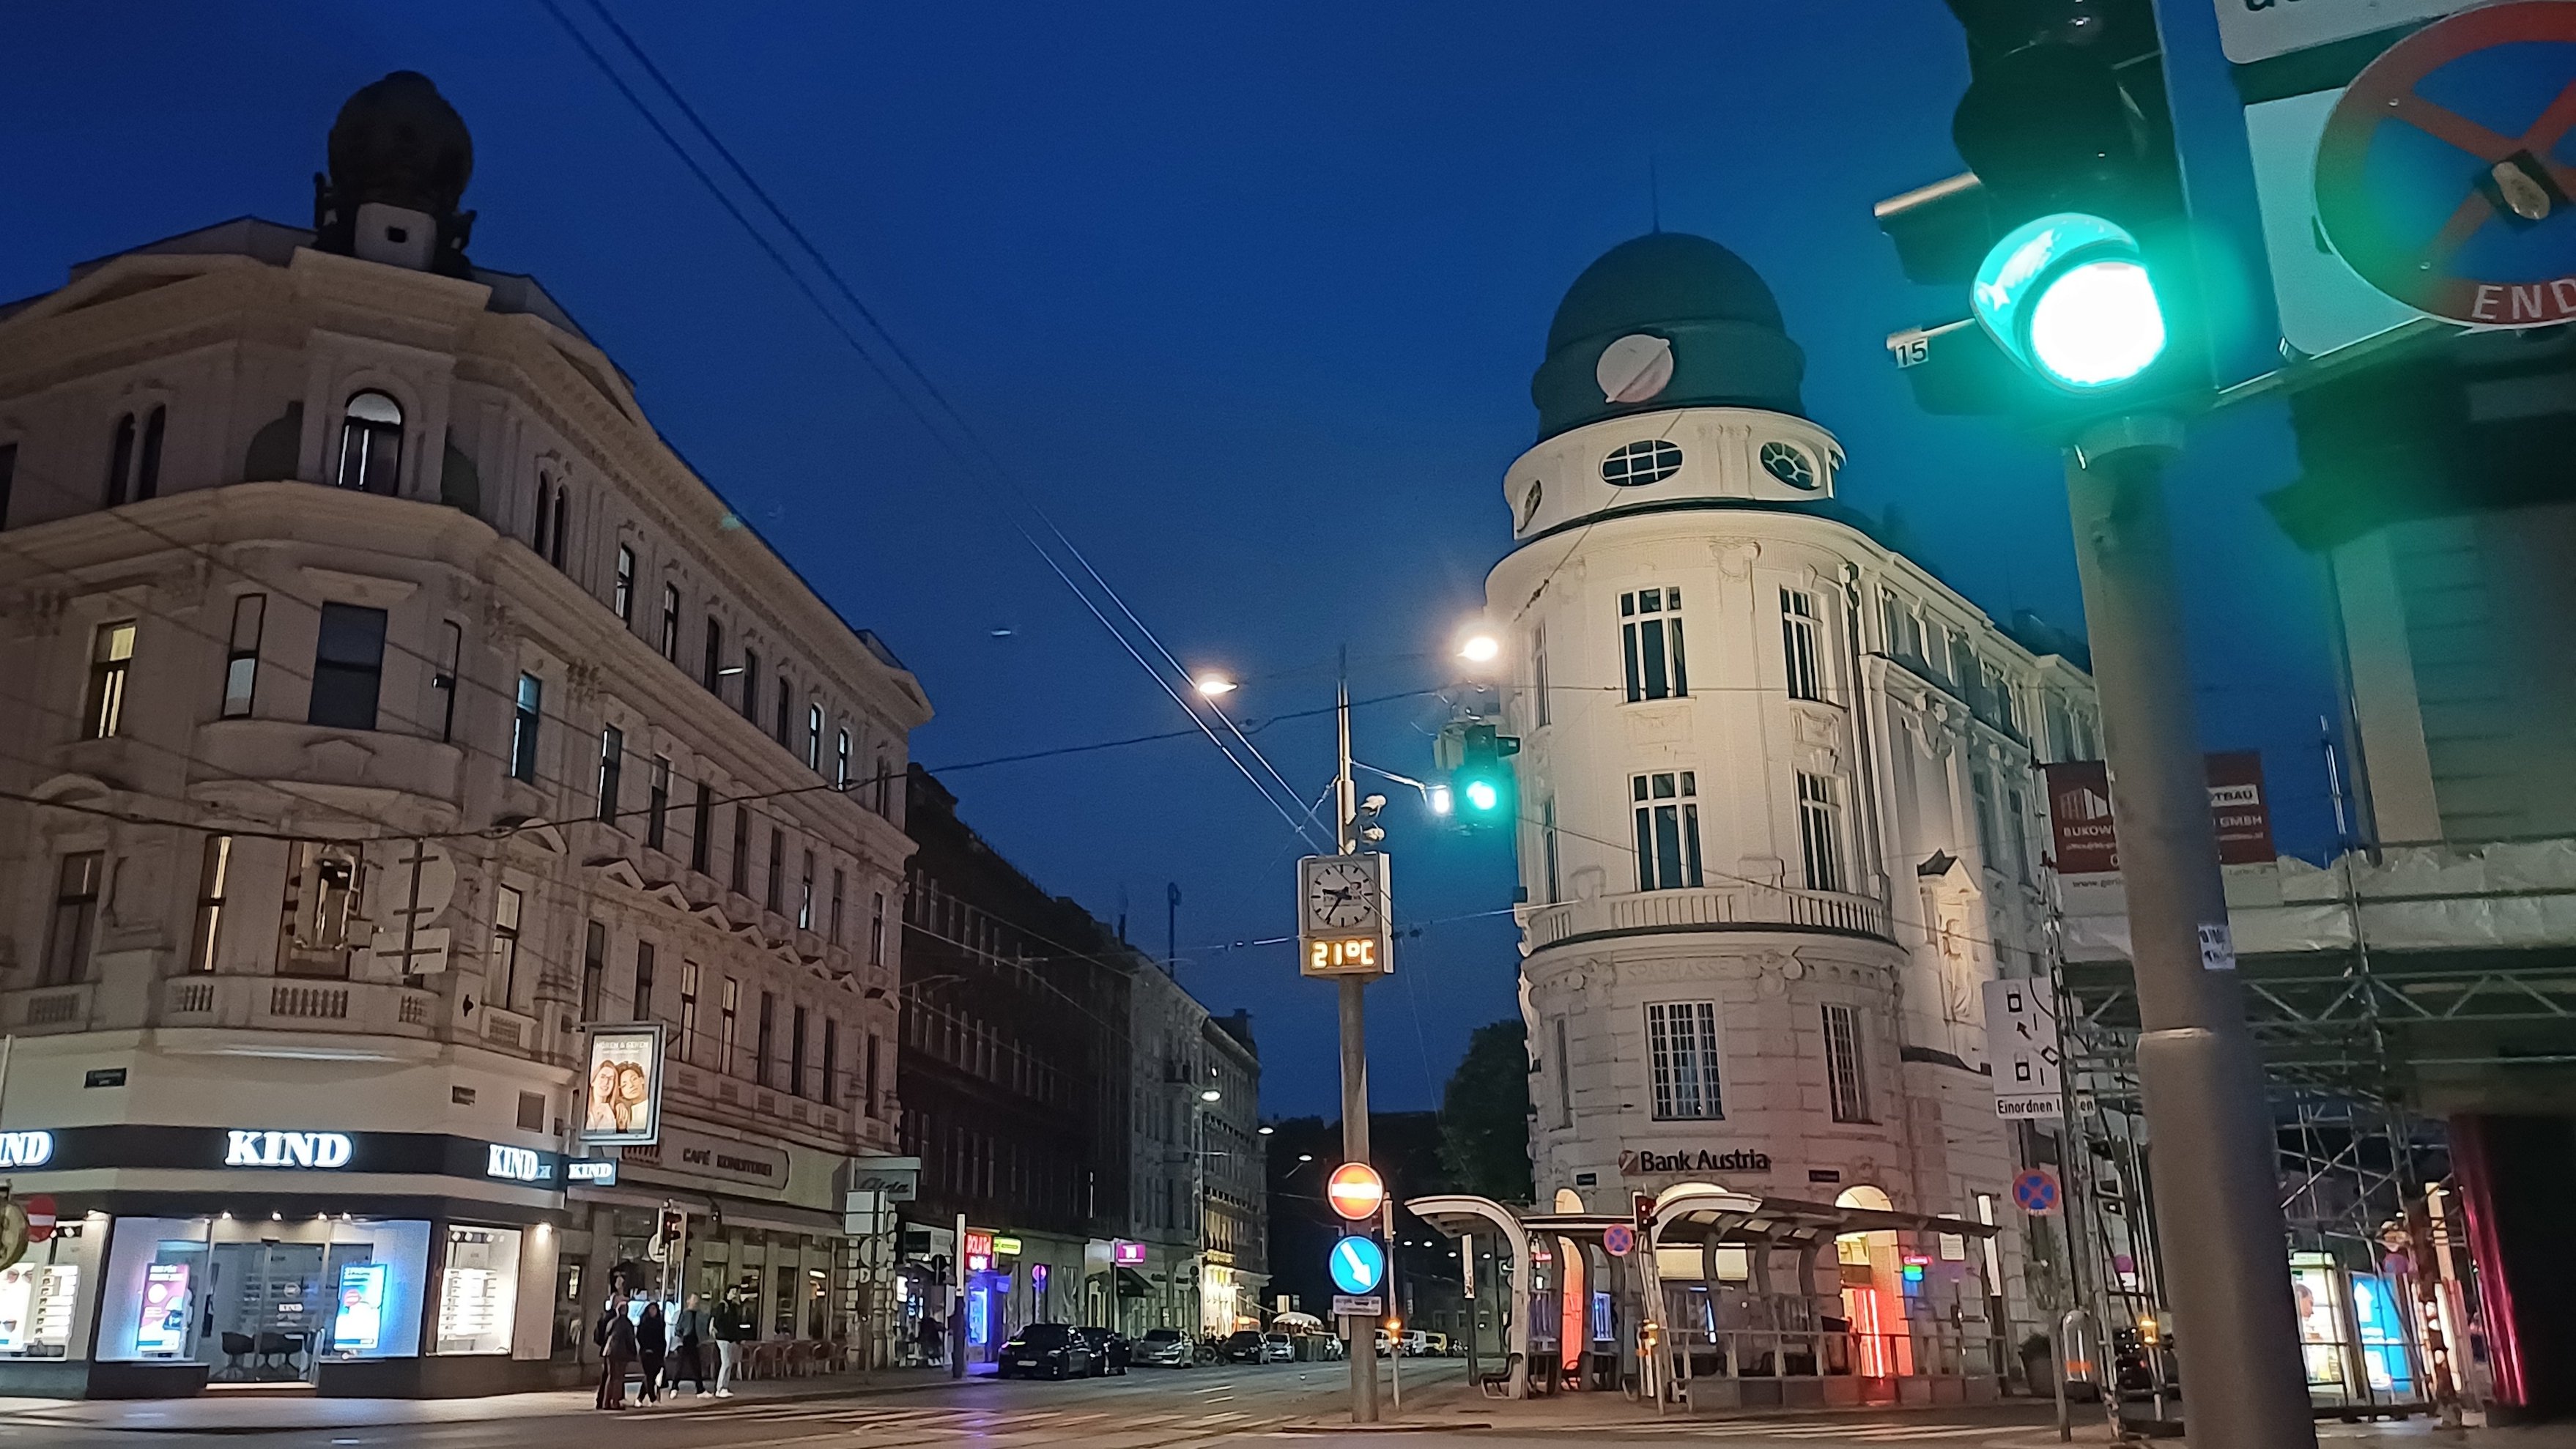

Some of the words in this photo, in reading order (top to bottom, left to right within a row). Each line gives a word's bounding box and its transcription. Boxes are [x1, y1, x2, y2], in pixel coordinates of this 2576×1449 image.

[1898, 340, 1926, 366] 15
[1311, 940, 1375, 968] 21°C
[1997, 1099, 2053, 1114] Einordnen
[225, 1130, 352, 1168] KIND
[1640, 1149, 1690, 1171] Bank
[1696, 1149, 1771, 1171] Austria
[487, 1144, 539, 1182] KIND
[568, 1163, 613, 1180] KIND
